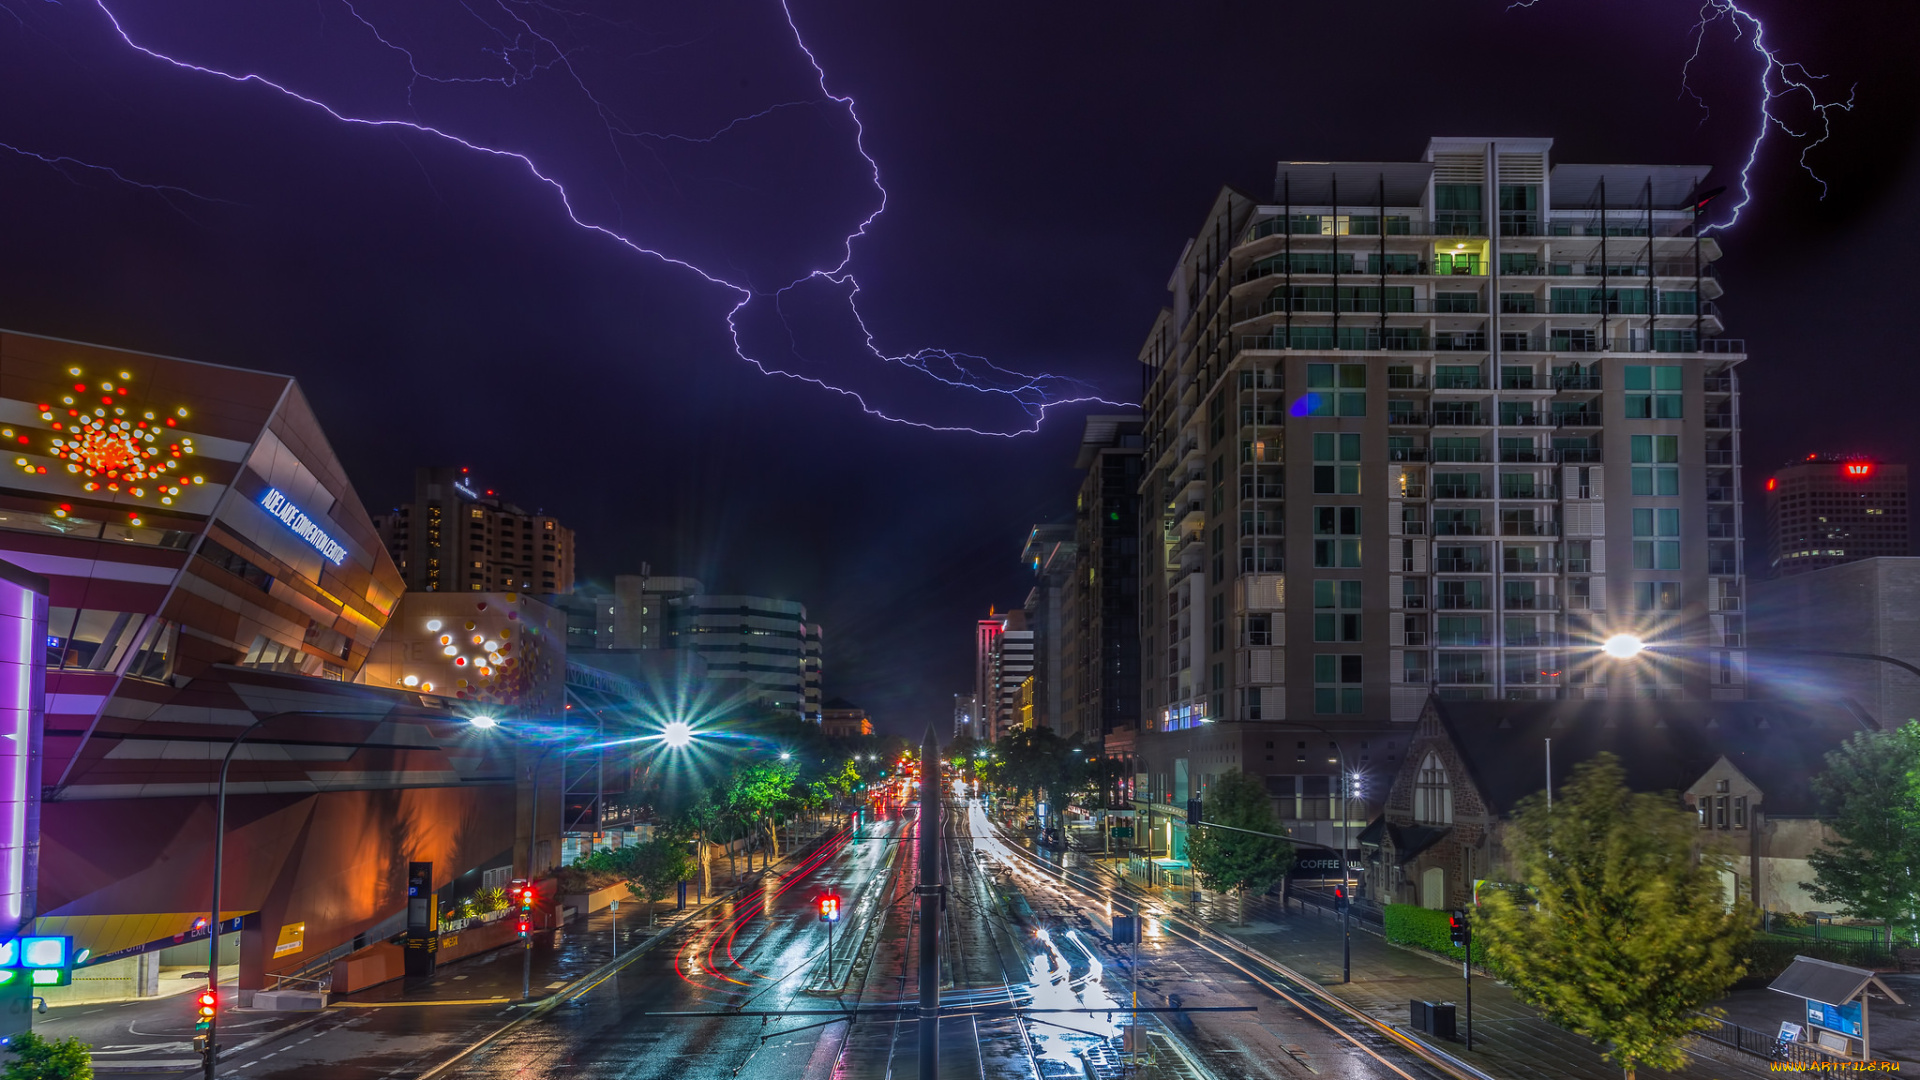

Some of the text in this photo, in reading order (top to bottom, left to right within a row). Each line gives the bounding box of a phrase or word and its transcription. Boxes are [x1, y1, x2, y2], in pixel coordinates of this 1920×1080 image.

[261, 488, 347, 566] ADELAIDE CONVENTION CENTRE
[1300, 859, 1340, 869] COFFEE
